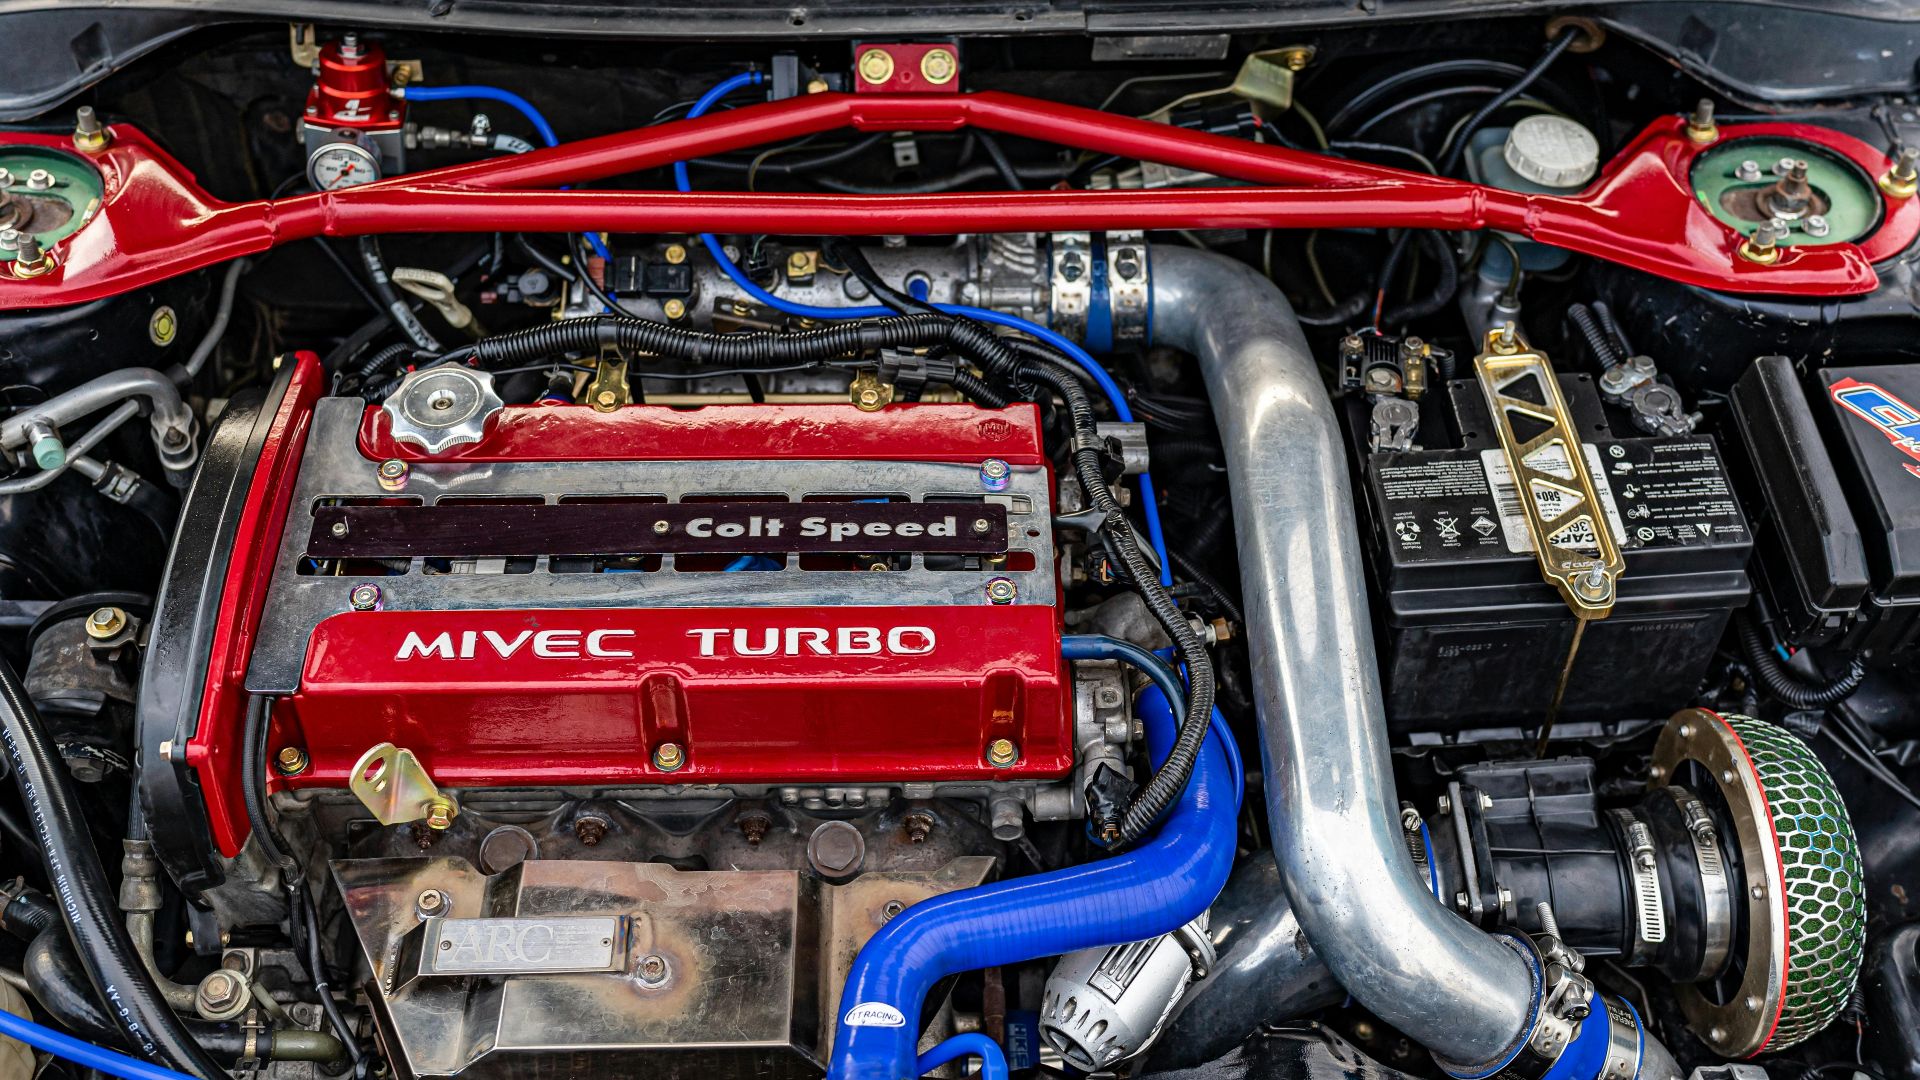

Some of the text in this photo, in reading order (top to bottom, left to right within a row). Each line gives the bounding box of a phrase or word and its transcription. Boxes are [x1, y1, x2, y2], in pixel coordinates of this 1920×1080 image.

[685, 515, 957, 542] Colt Speed
[396, 625, 937, 661] MIVEC TURBO
[47, 848, 63, 871] JPN
[56, 873, 82, 923] NICHIRIN
[446, 923, 554, 964] ARC
[863, 1010, 898, 1022] RACING
